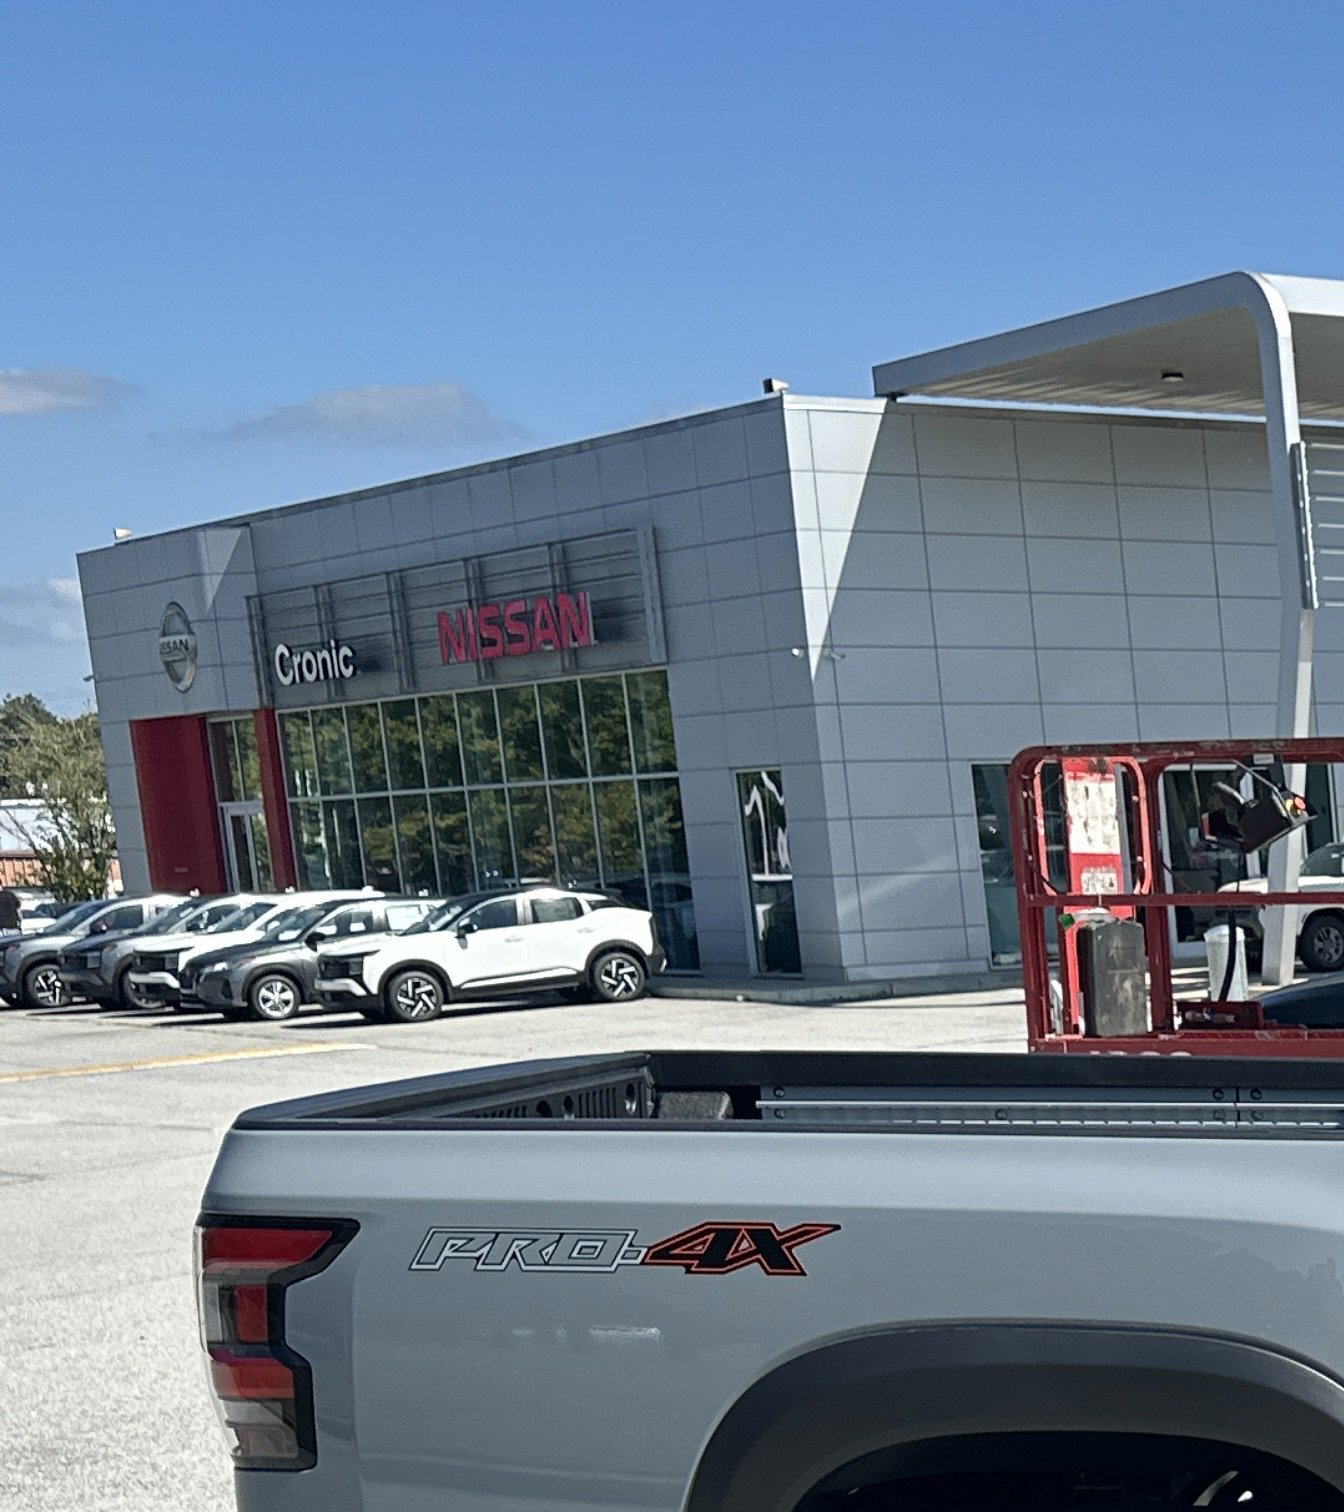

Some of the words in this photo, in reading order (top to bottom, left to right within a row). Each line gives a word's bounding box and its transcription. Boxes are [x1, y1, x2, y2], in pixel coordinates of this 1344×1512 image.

[274, 639, 354, 686] Cronic
[436, 591, 592, 665] NISSAN
[408, 1220, 842, 1277] PRO-4X
